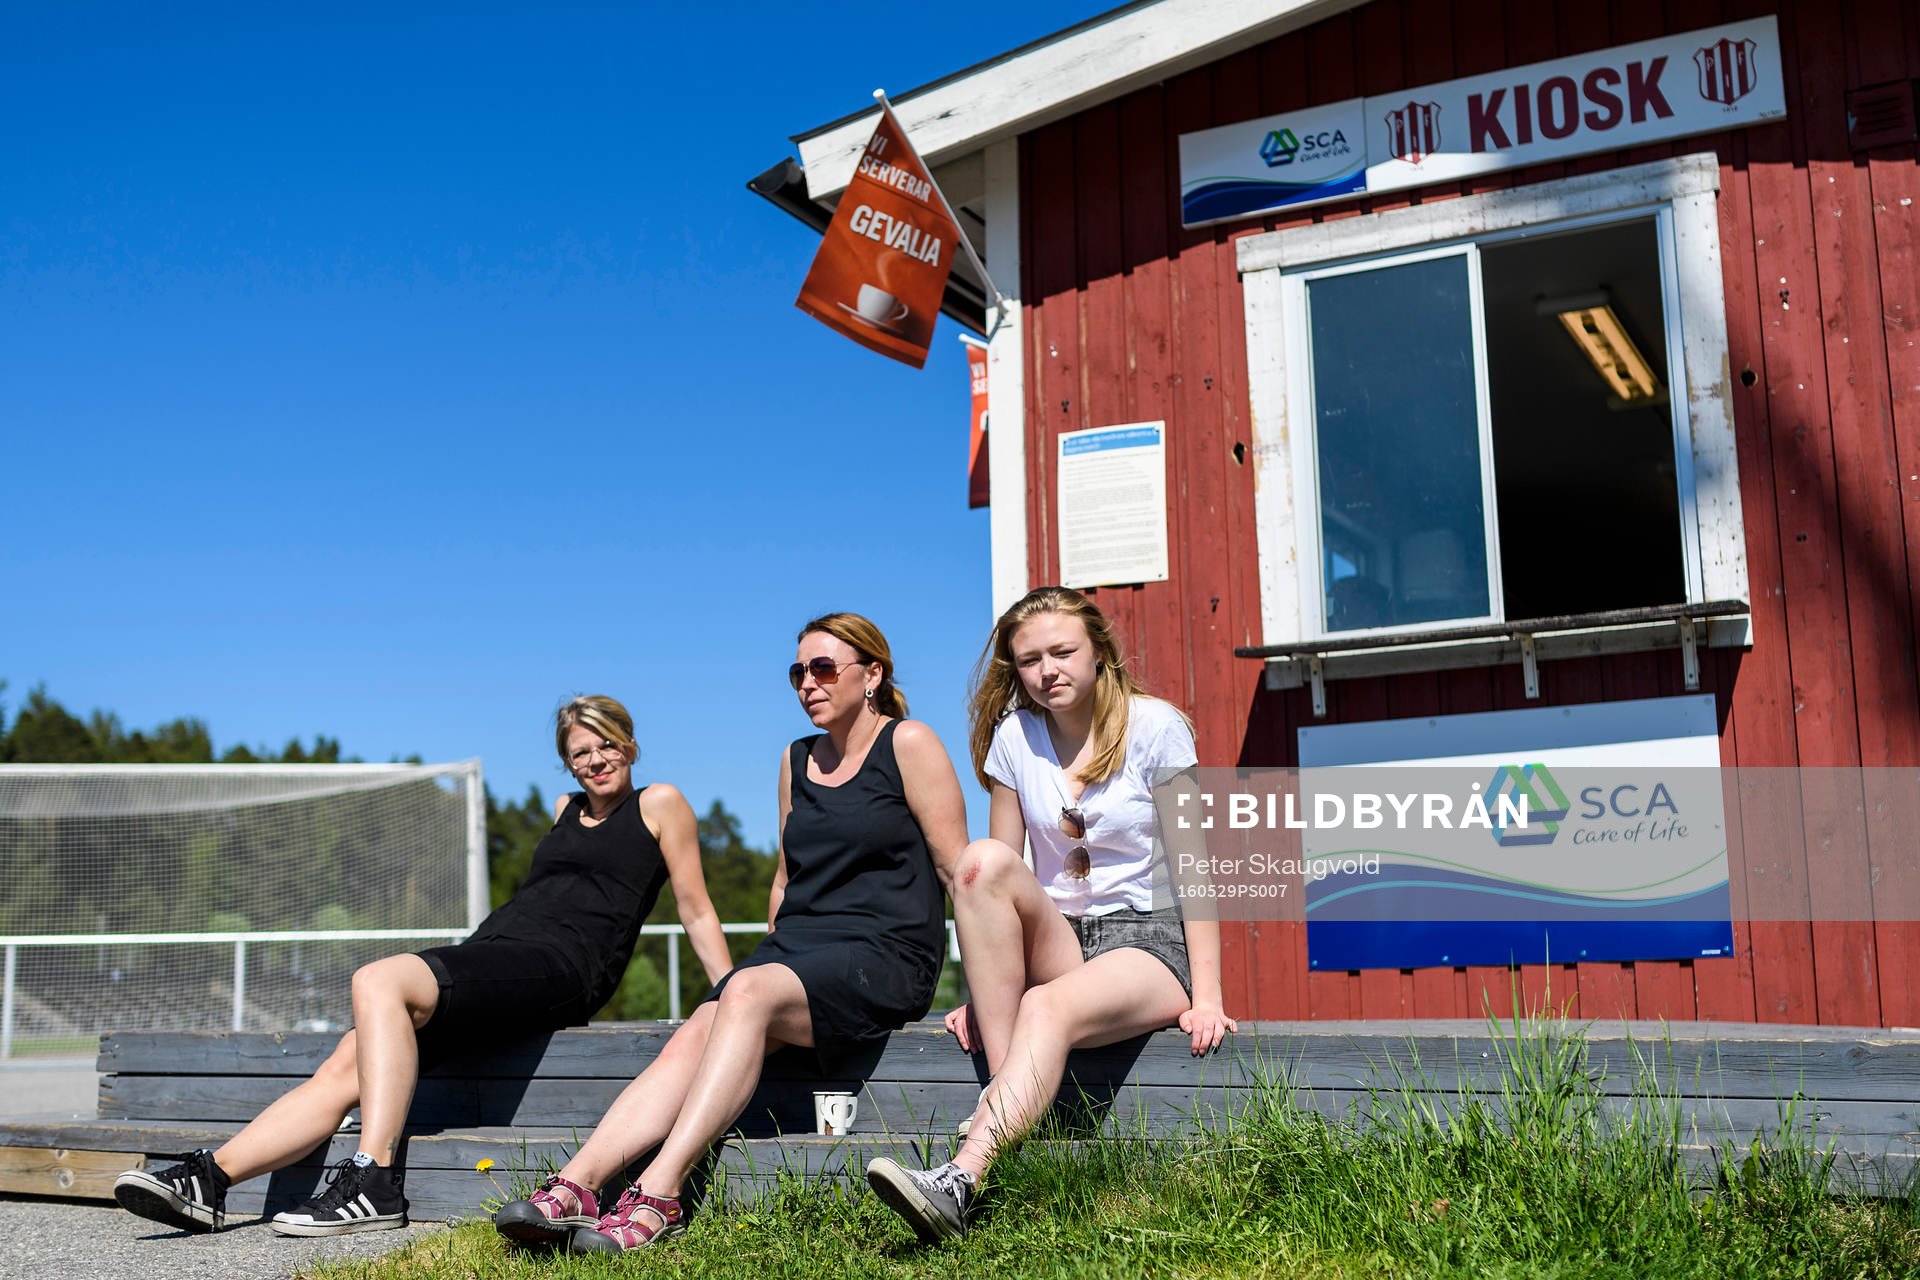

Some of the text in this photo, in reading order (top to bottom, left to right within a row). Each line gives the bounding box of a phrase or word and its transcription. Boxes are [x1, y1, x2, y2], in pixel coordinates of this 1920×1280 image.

[1467, 56, 1674, 153] KIOSK
[870, 134, 888, 155] VI
[1303, 129, 1347, 151] SCA
[859, 155, 932, 202] SERVERAR
[850, 204, 941, 267] GEVALIA
[1580, 782, 1679, 819] SCA
[1573, 817, 1688, 845] Care of Life
